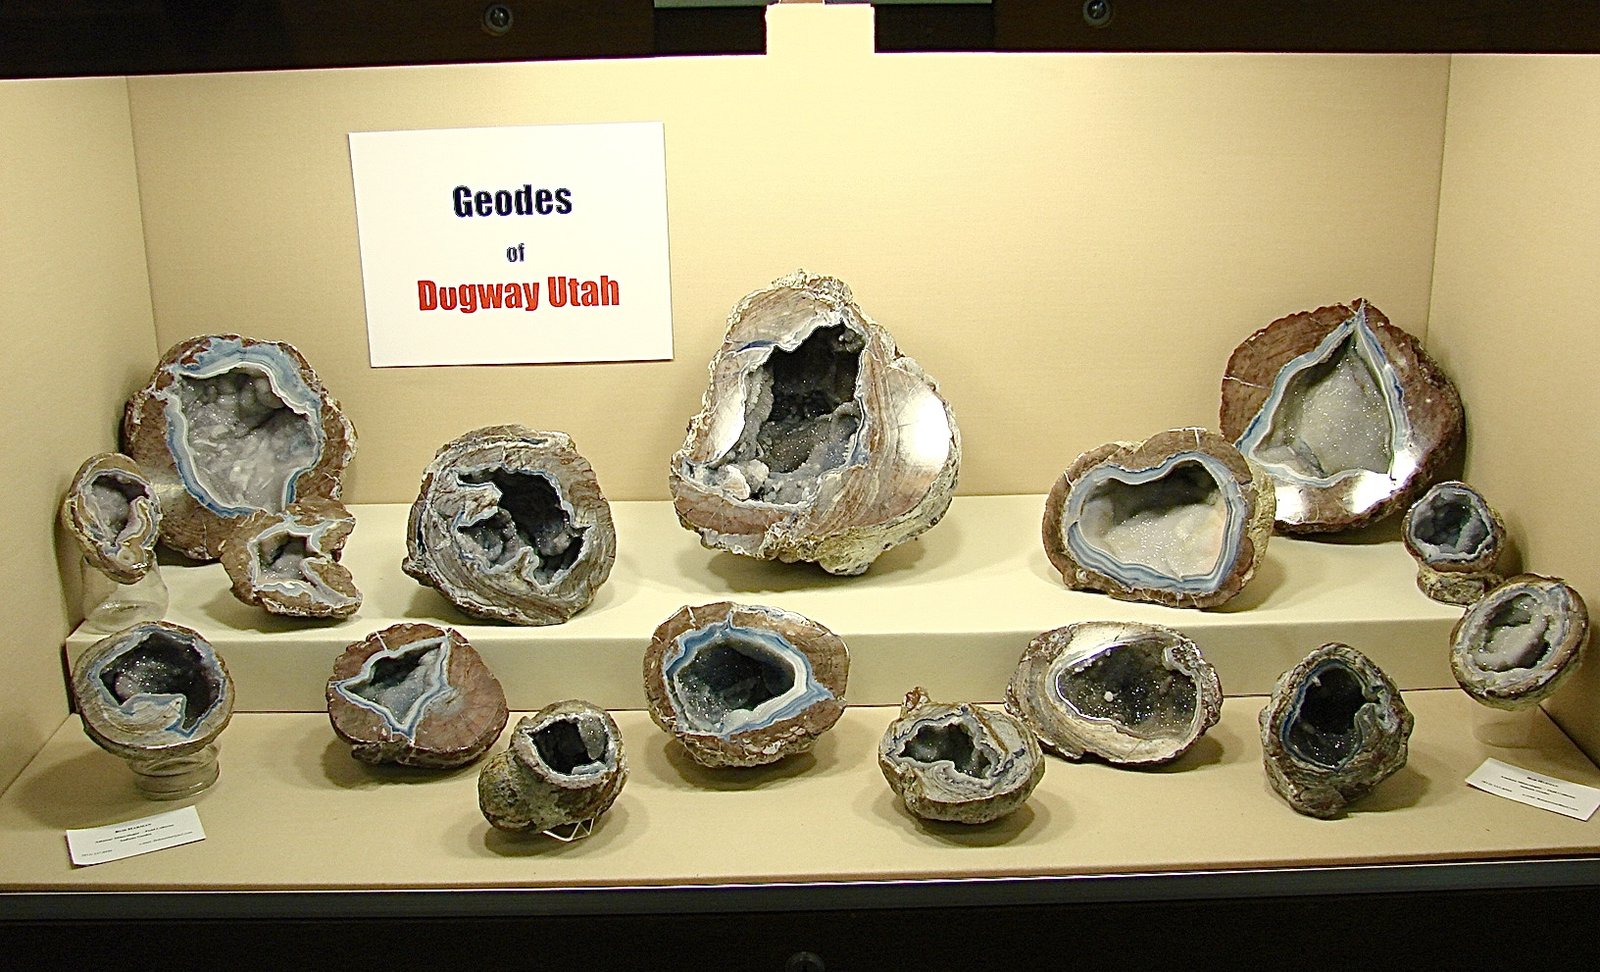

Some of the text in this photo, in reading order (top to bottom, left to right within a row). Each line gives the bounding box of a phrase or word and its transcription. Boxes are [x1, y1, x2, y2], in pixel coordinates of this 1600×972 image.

[453, 184, 572, 217] Geodes
[507, 243, 524, 262] of
[417, 275, 620, 313] Dugway Utah
